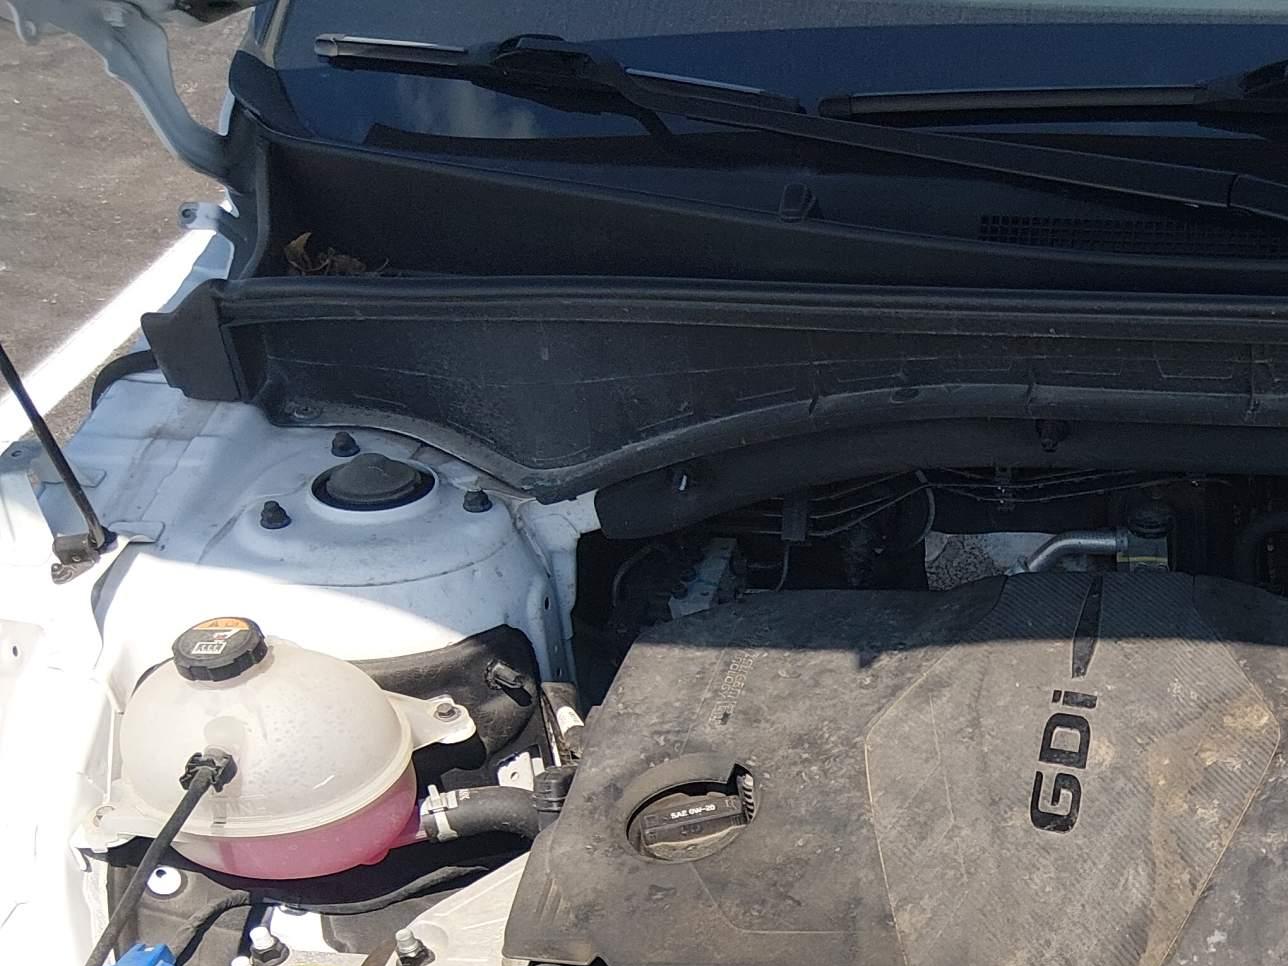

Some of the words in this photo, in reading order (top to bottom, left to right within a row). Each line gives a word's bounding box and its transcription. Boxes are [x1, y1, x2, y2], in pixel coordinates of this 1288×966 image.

[1030, 689, 1098, 833] GDi
[670, 810, 688, 820] SAE
[688, 803, 716, 816] 0W-20
